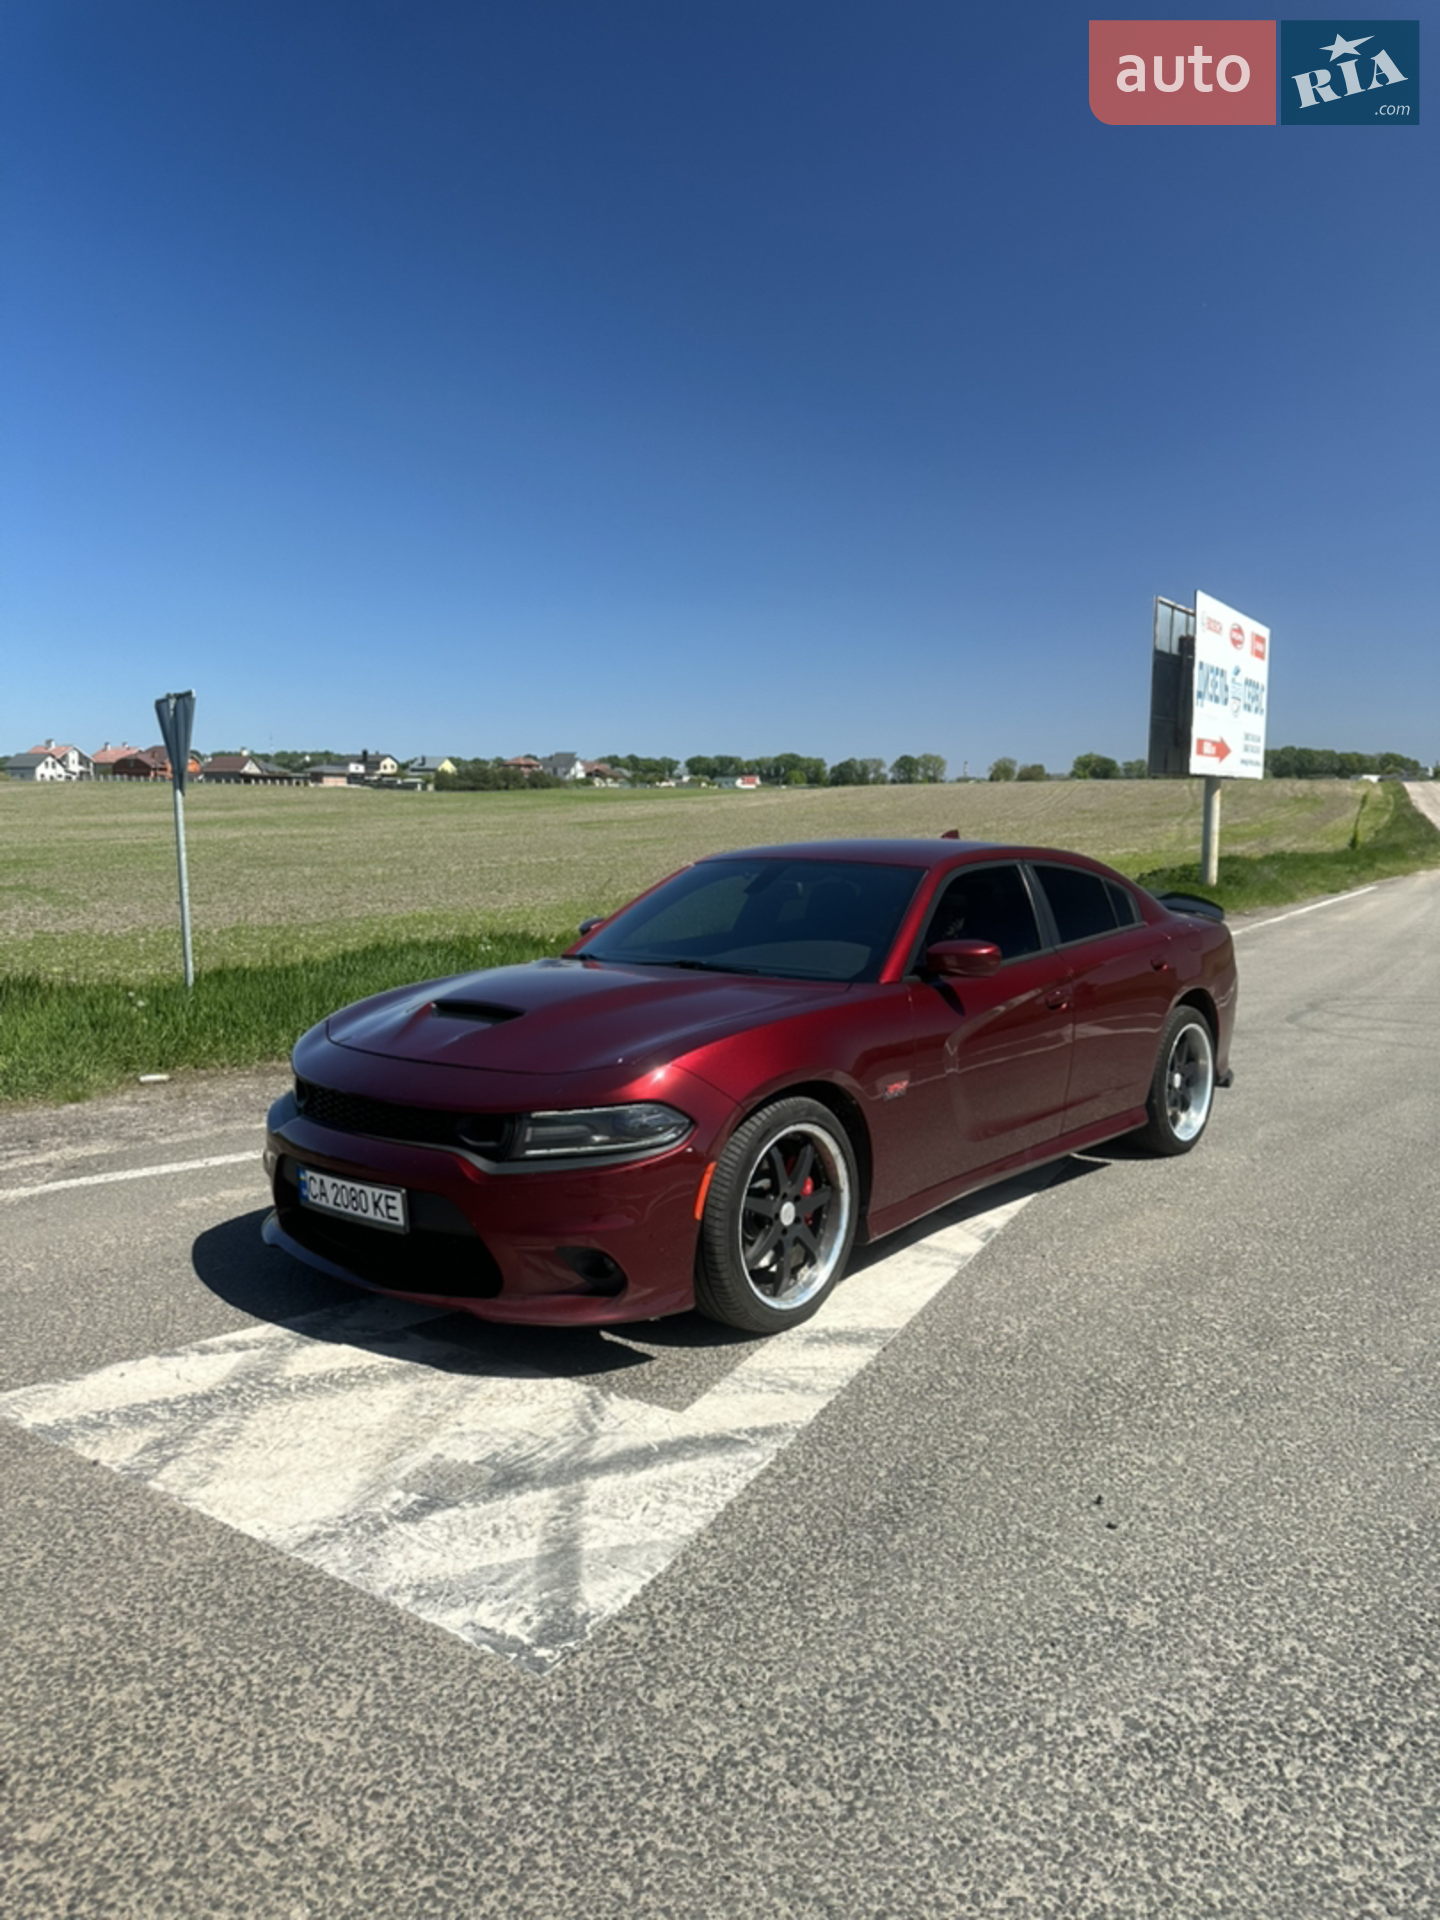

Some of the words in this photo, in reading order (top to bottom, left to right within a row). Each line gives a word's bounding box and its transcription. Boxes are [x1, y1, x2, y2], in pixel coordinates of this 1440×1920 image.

[308, 1176, 330, 1204] CA
[331, 1182, 369, 1214] 2080
[372, 1191, 399, 1222] KE
